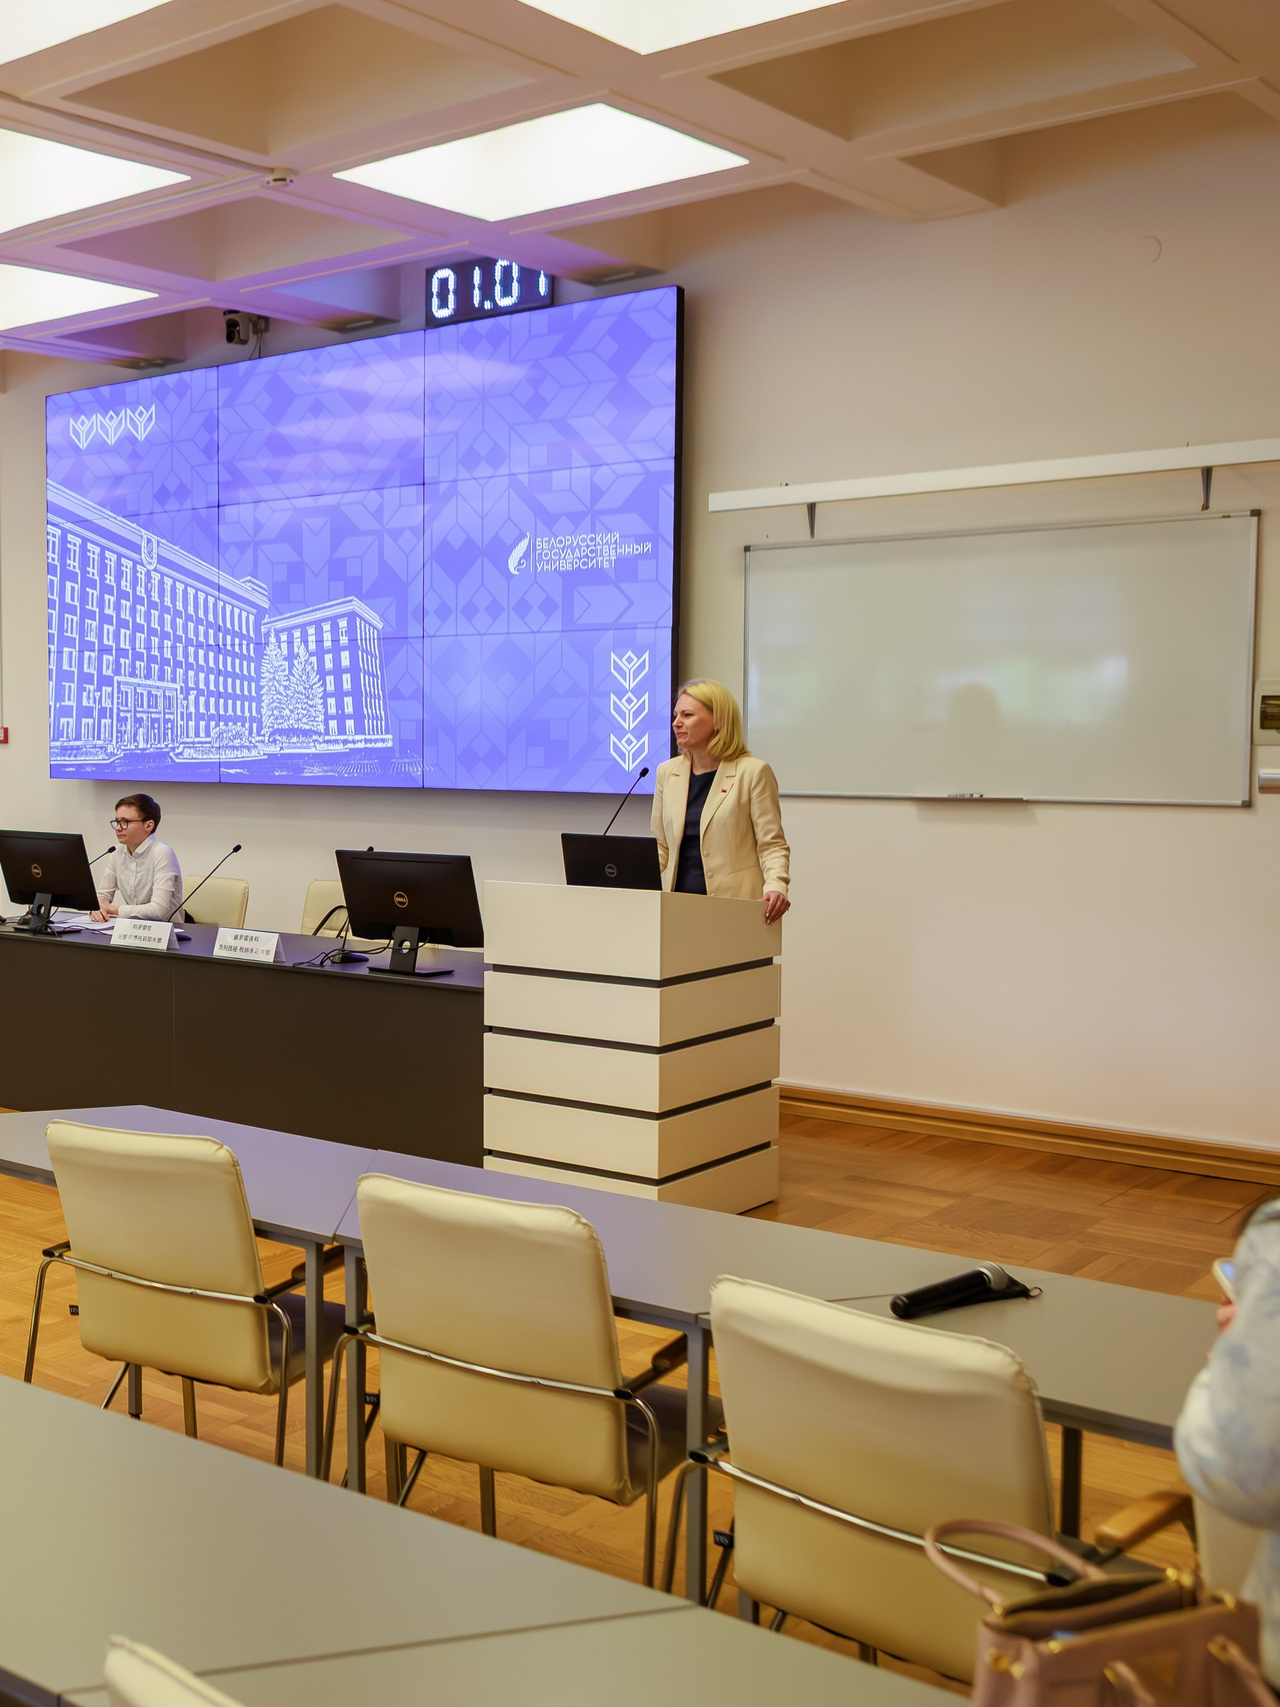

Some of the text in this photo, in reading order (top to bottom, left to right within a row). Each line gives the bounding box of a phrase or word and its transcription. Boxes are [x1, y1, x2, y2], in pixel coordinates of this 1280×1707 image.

[536, 532, 620, 549] БЕЛОРУССКИЙ
[536, 542, 652, 560] ГОСУДАРСТВЕННЫЙ
[536, 556, 617, 572] УНИВЕРСИТЕТ
